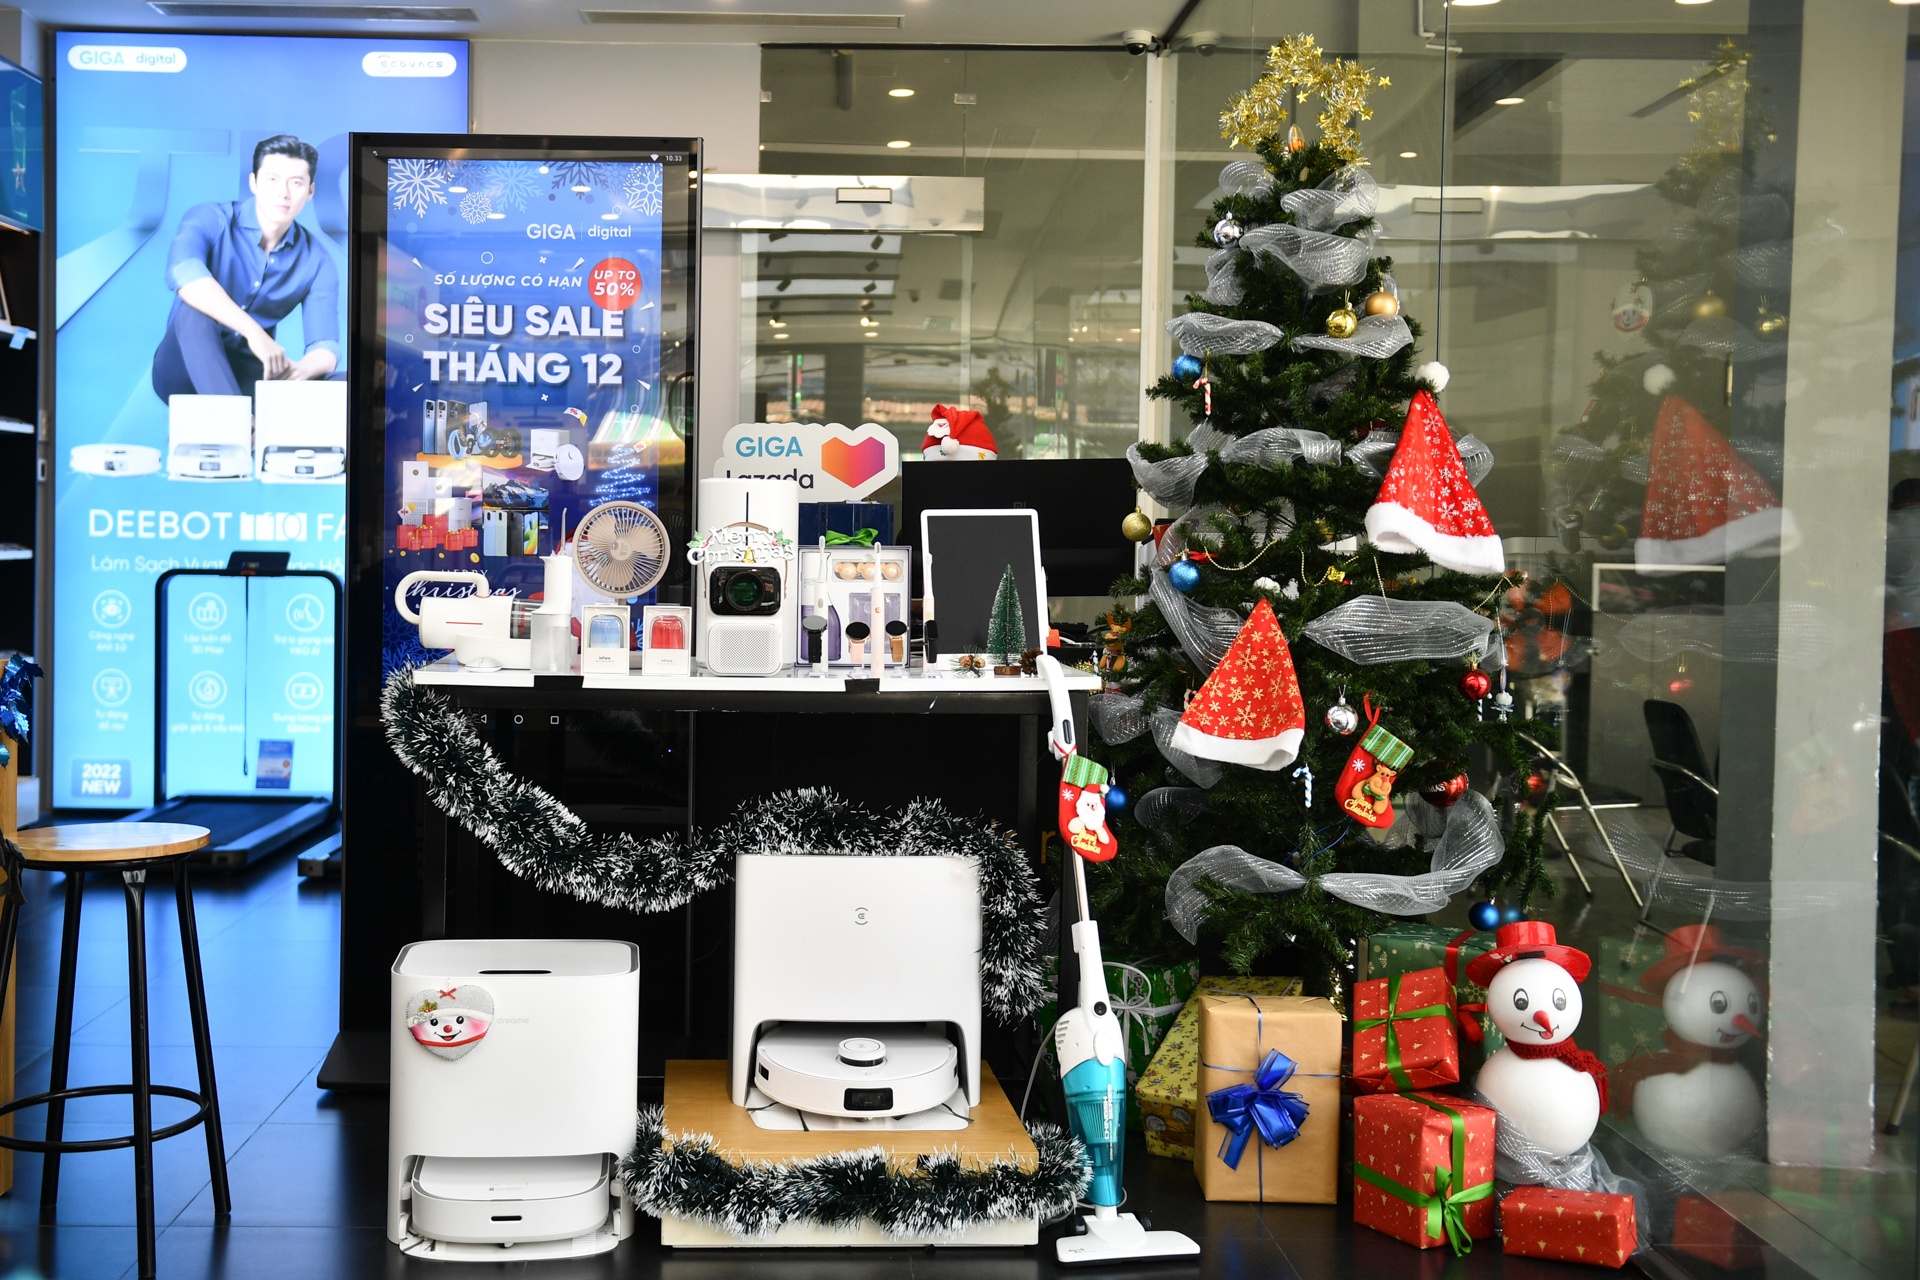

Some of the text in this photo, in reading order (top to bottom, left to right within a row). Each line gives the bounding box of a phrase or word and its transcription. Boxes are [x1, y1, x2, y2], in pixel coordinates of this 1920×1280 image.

[80, 50, 176, 66] GIGA digital
[526, 223, 631, 240] GIGA digital
[434, 270, 583, 290] SỐ LƯỢNG CÓ HẠN
[594, 270, 636, 280] UP TO
[594, 281, 635, 296] 50%
[423, 296, 625, 338] SIÊU SALE
[423, 344, 623, 386] THÁNG 12
[735, 436, 804, 458] GIGA
[89, 509, 233, 540] DEEBOT
[706, 526, 776, 547] Merry
[91, 554, 130, 571] Làm
[686, 543, 796, 566] Chrismas
[82, 763, 122, 779] 2022
[81, 779, 122, 796] NEW
[496, 1016, 530, 1024] dreame
